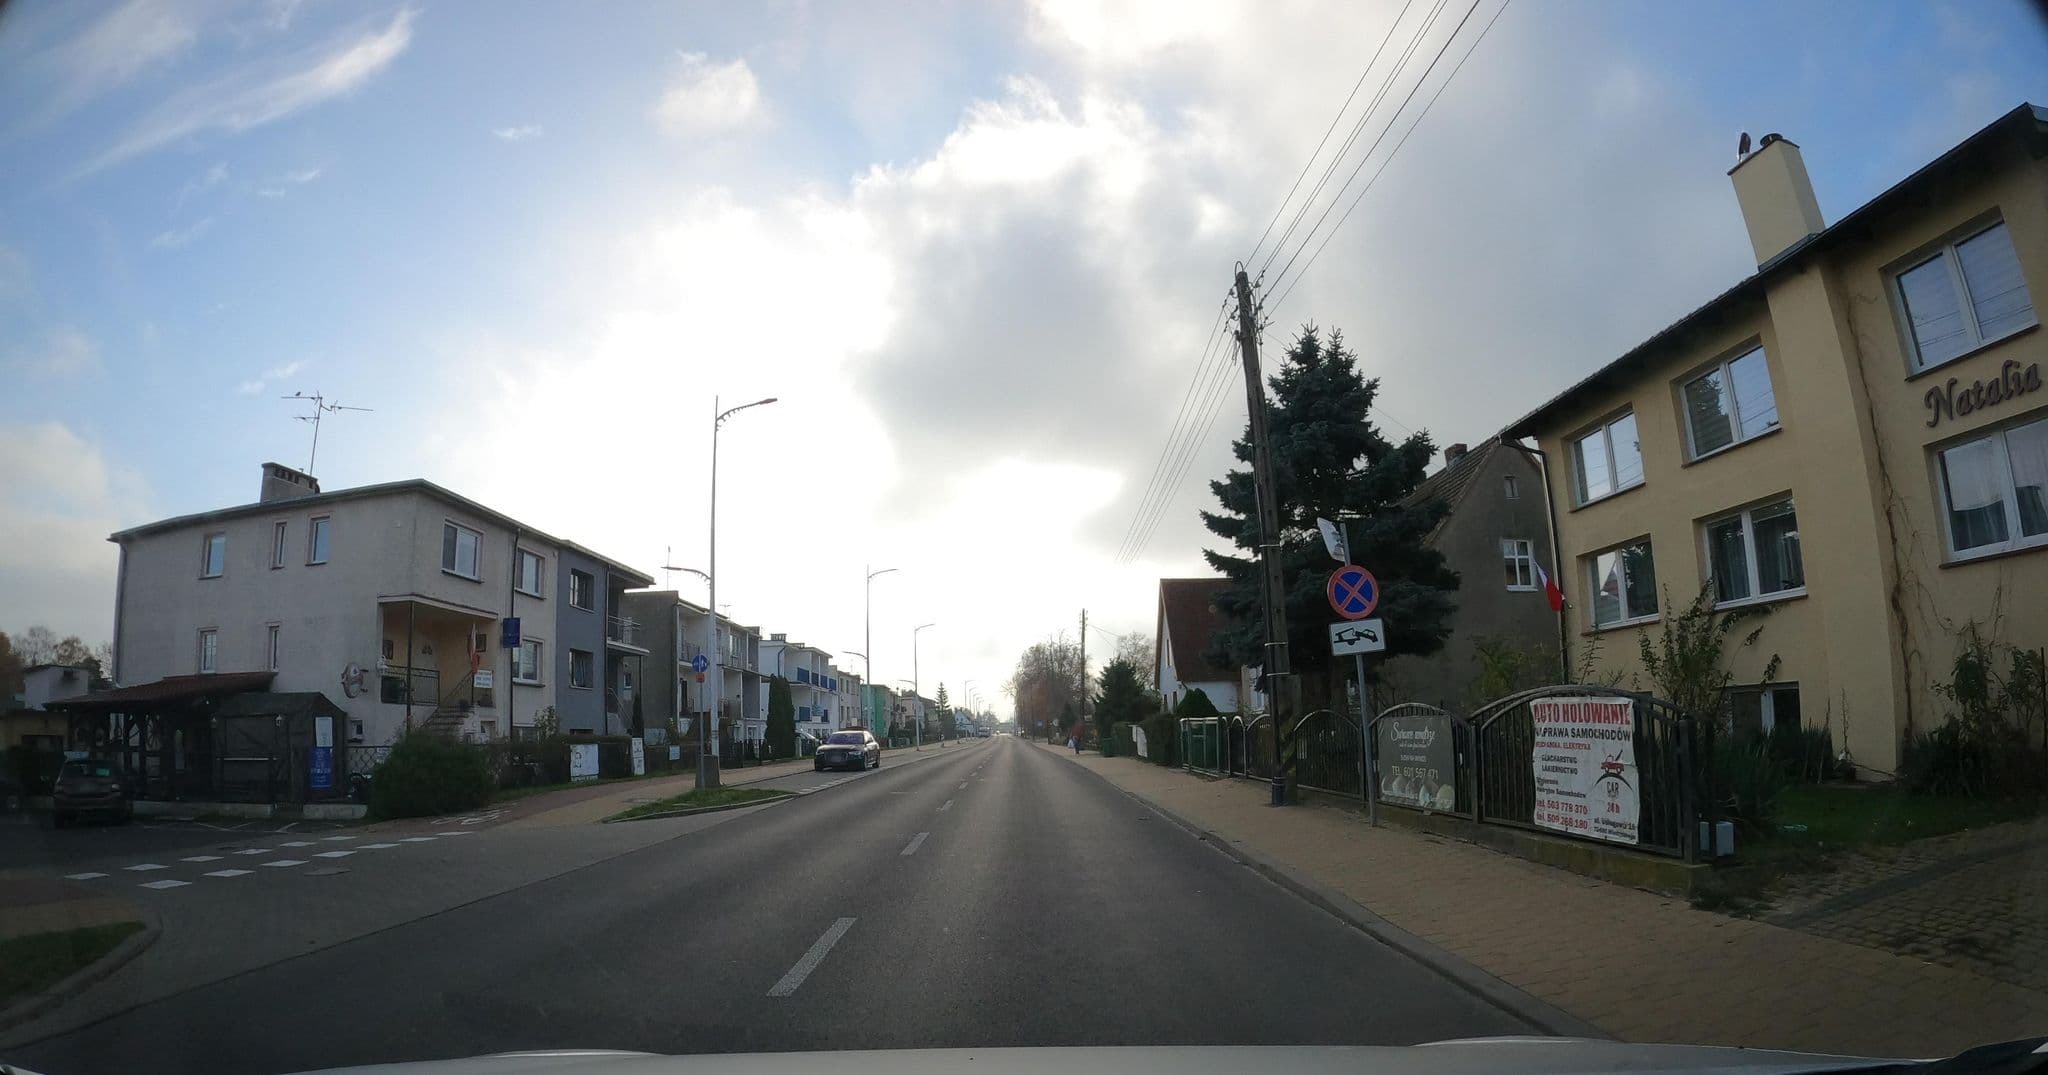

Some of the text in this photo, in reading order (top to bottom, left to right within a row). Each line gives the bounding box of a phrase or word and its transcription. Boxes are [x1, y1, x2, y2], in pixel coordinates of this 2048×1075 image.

[1924, 359, 2042, 428] Natalia
[1534, 703, 1631, 725] AUTO HOLOWANIE
[1571, 727, 1631, 742] SAMOCHODÓW
[1574, 804, 1588, 815] 370
